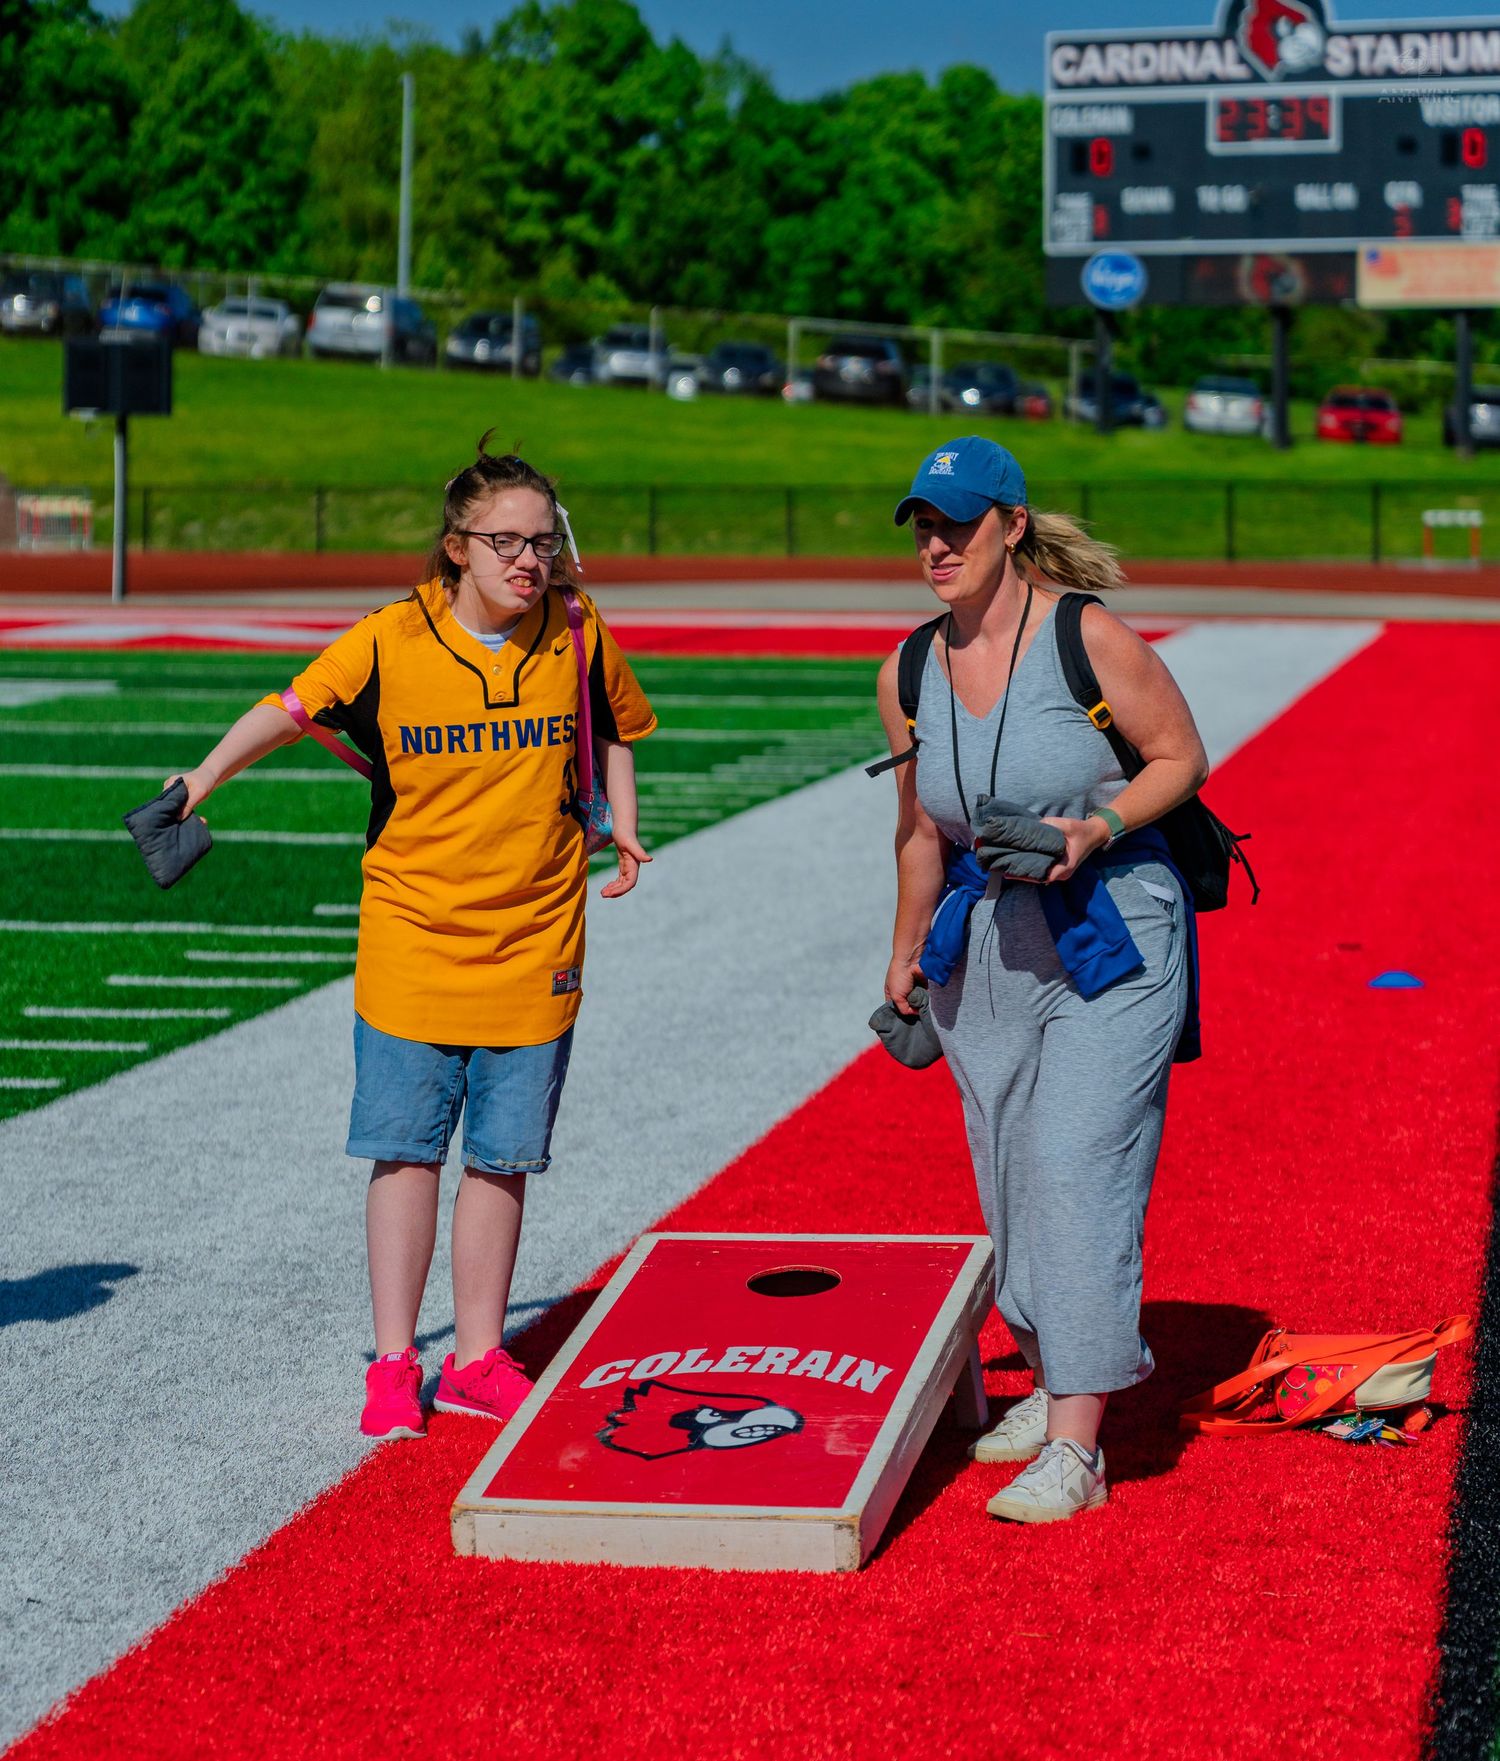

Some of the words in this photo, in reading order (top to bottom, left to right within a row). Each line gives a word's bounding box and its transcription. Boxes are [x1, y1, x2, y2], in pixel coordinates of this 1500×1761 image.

[1052, 40, 1250, 85] CARDINAL
[1324, 31, 1500, 77] STADIUM
[1089, 137, 1113, 178] 0
[1461, 127, 1486, 169] 0
[398, 711, 578, 755] NORTHWES
[579, 1346, 894, 1394] COLERAIN
